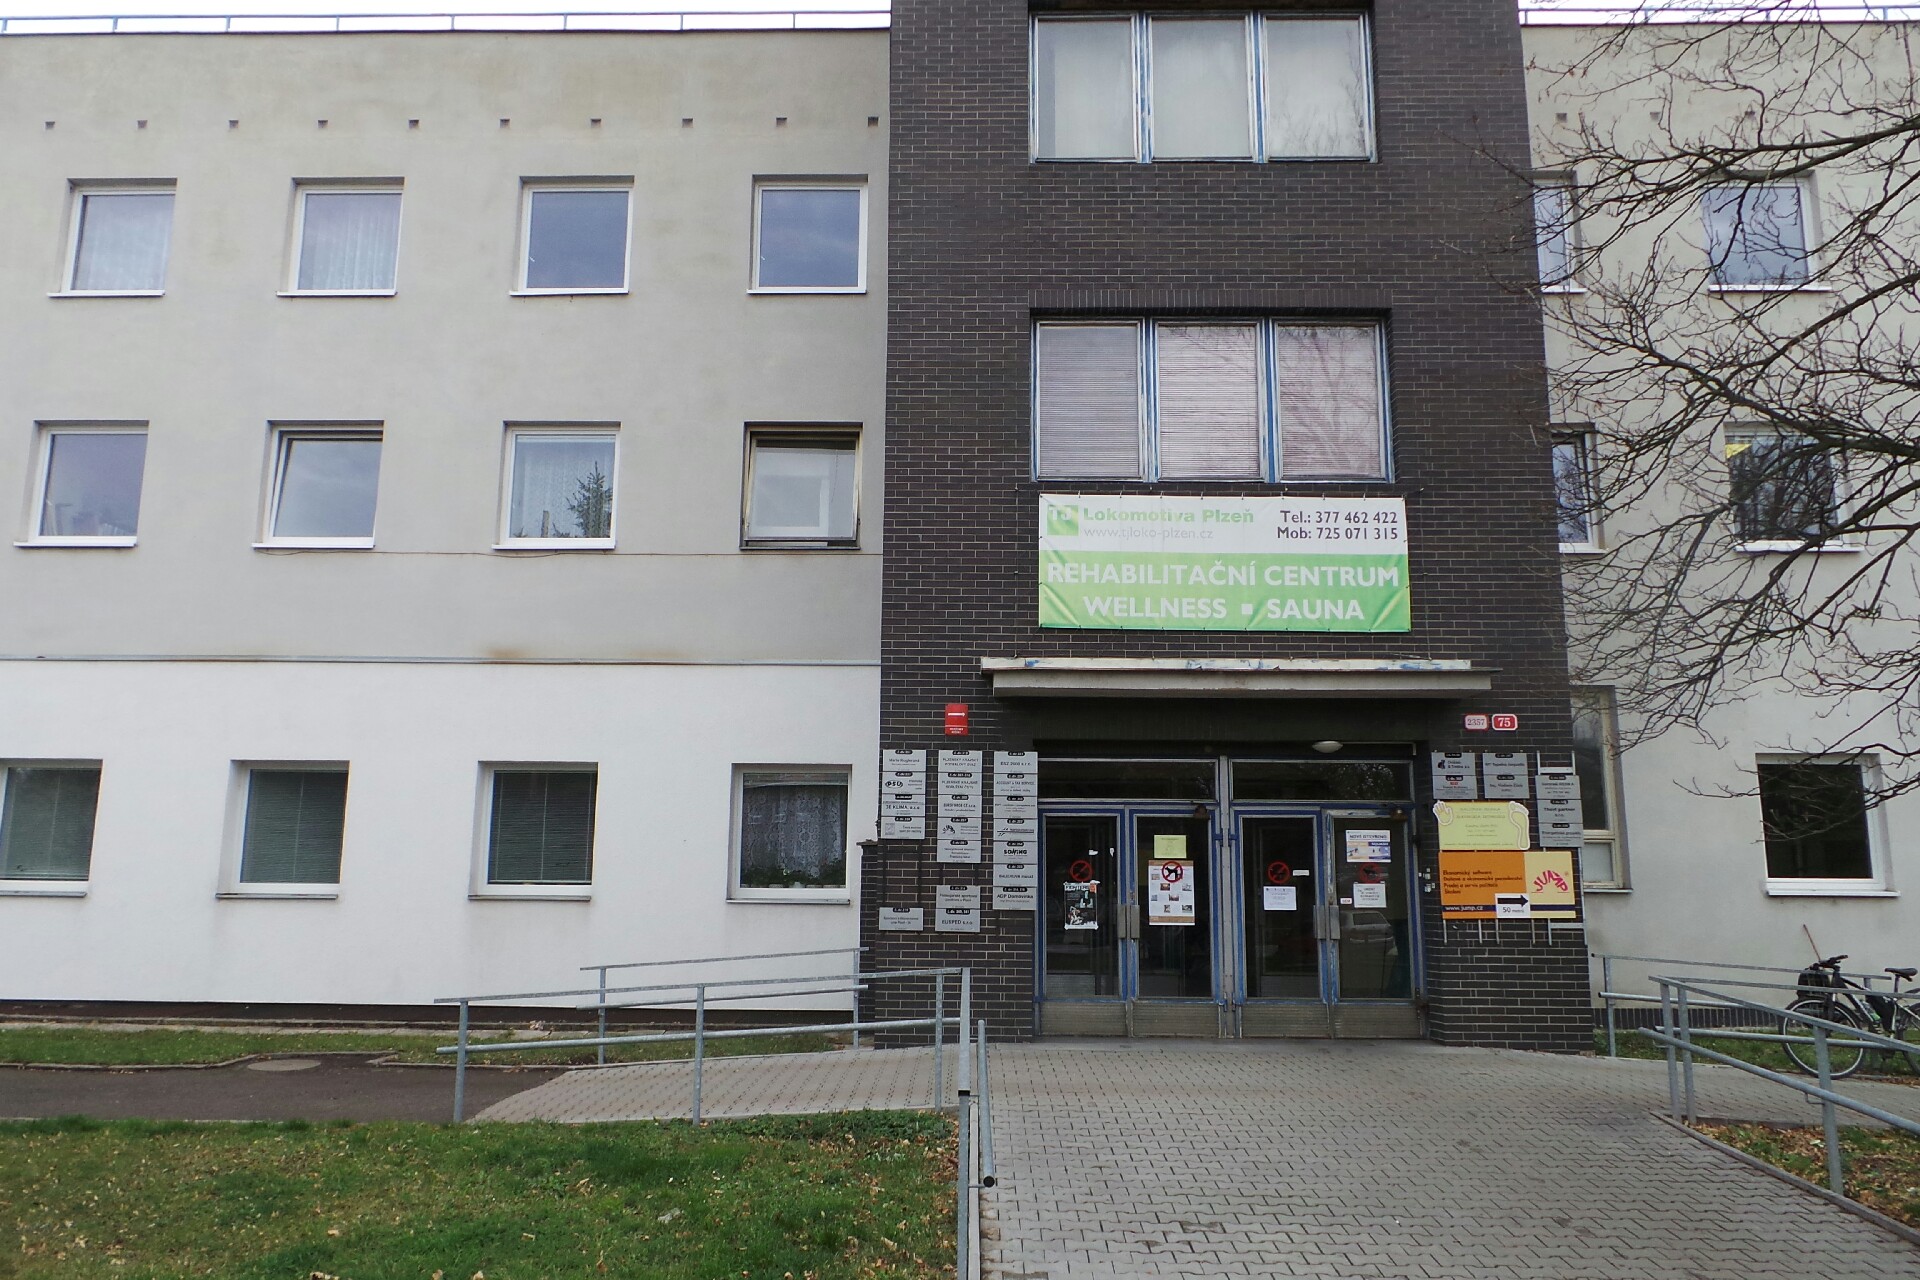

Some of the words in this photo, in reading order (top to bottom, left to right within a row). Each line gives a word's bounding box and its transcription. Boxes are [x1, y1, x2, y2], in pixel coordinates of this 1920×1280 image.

[1048, 506, 1072, 521] TJ
[1083, 507, 1195, 523] Lokomotiva
[1202, 508, 1254, 523] Plzeň
[1280, 510, 1311, 523] Tel.:
[1315, 511, 1340, 524] 377
[1344, 512, 1369, 524] 462
[1372, 512, 1398, 524] 422
[1083, 527, 1214, 540] www.tjloko-plzen.cz
[1277, 526, 1312, 539] Mob:
[1316, 527, 1341, 540] 725
[1345, 528, 1367, 540] 071
[1374, 528, 1398, 540] 315
[1047, 560, 1256, 586] REHABILITAČNÍ
[1264, 565, 1399, 587] CENTRUM
[1083, 596, 1227, 619] WELLNESS
[1267, 599, 1365, 620] SAUNA
[1498, 717, 1511, 728] 75
[1532, 870, 1568, 892] JUMP
